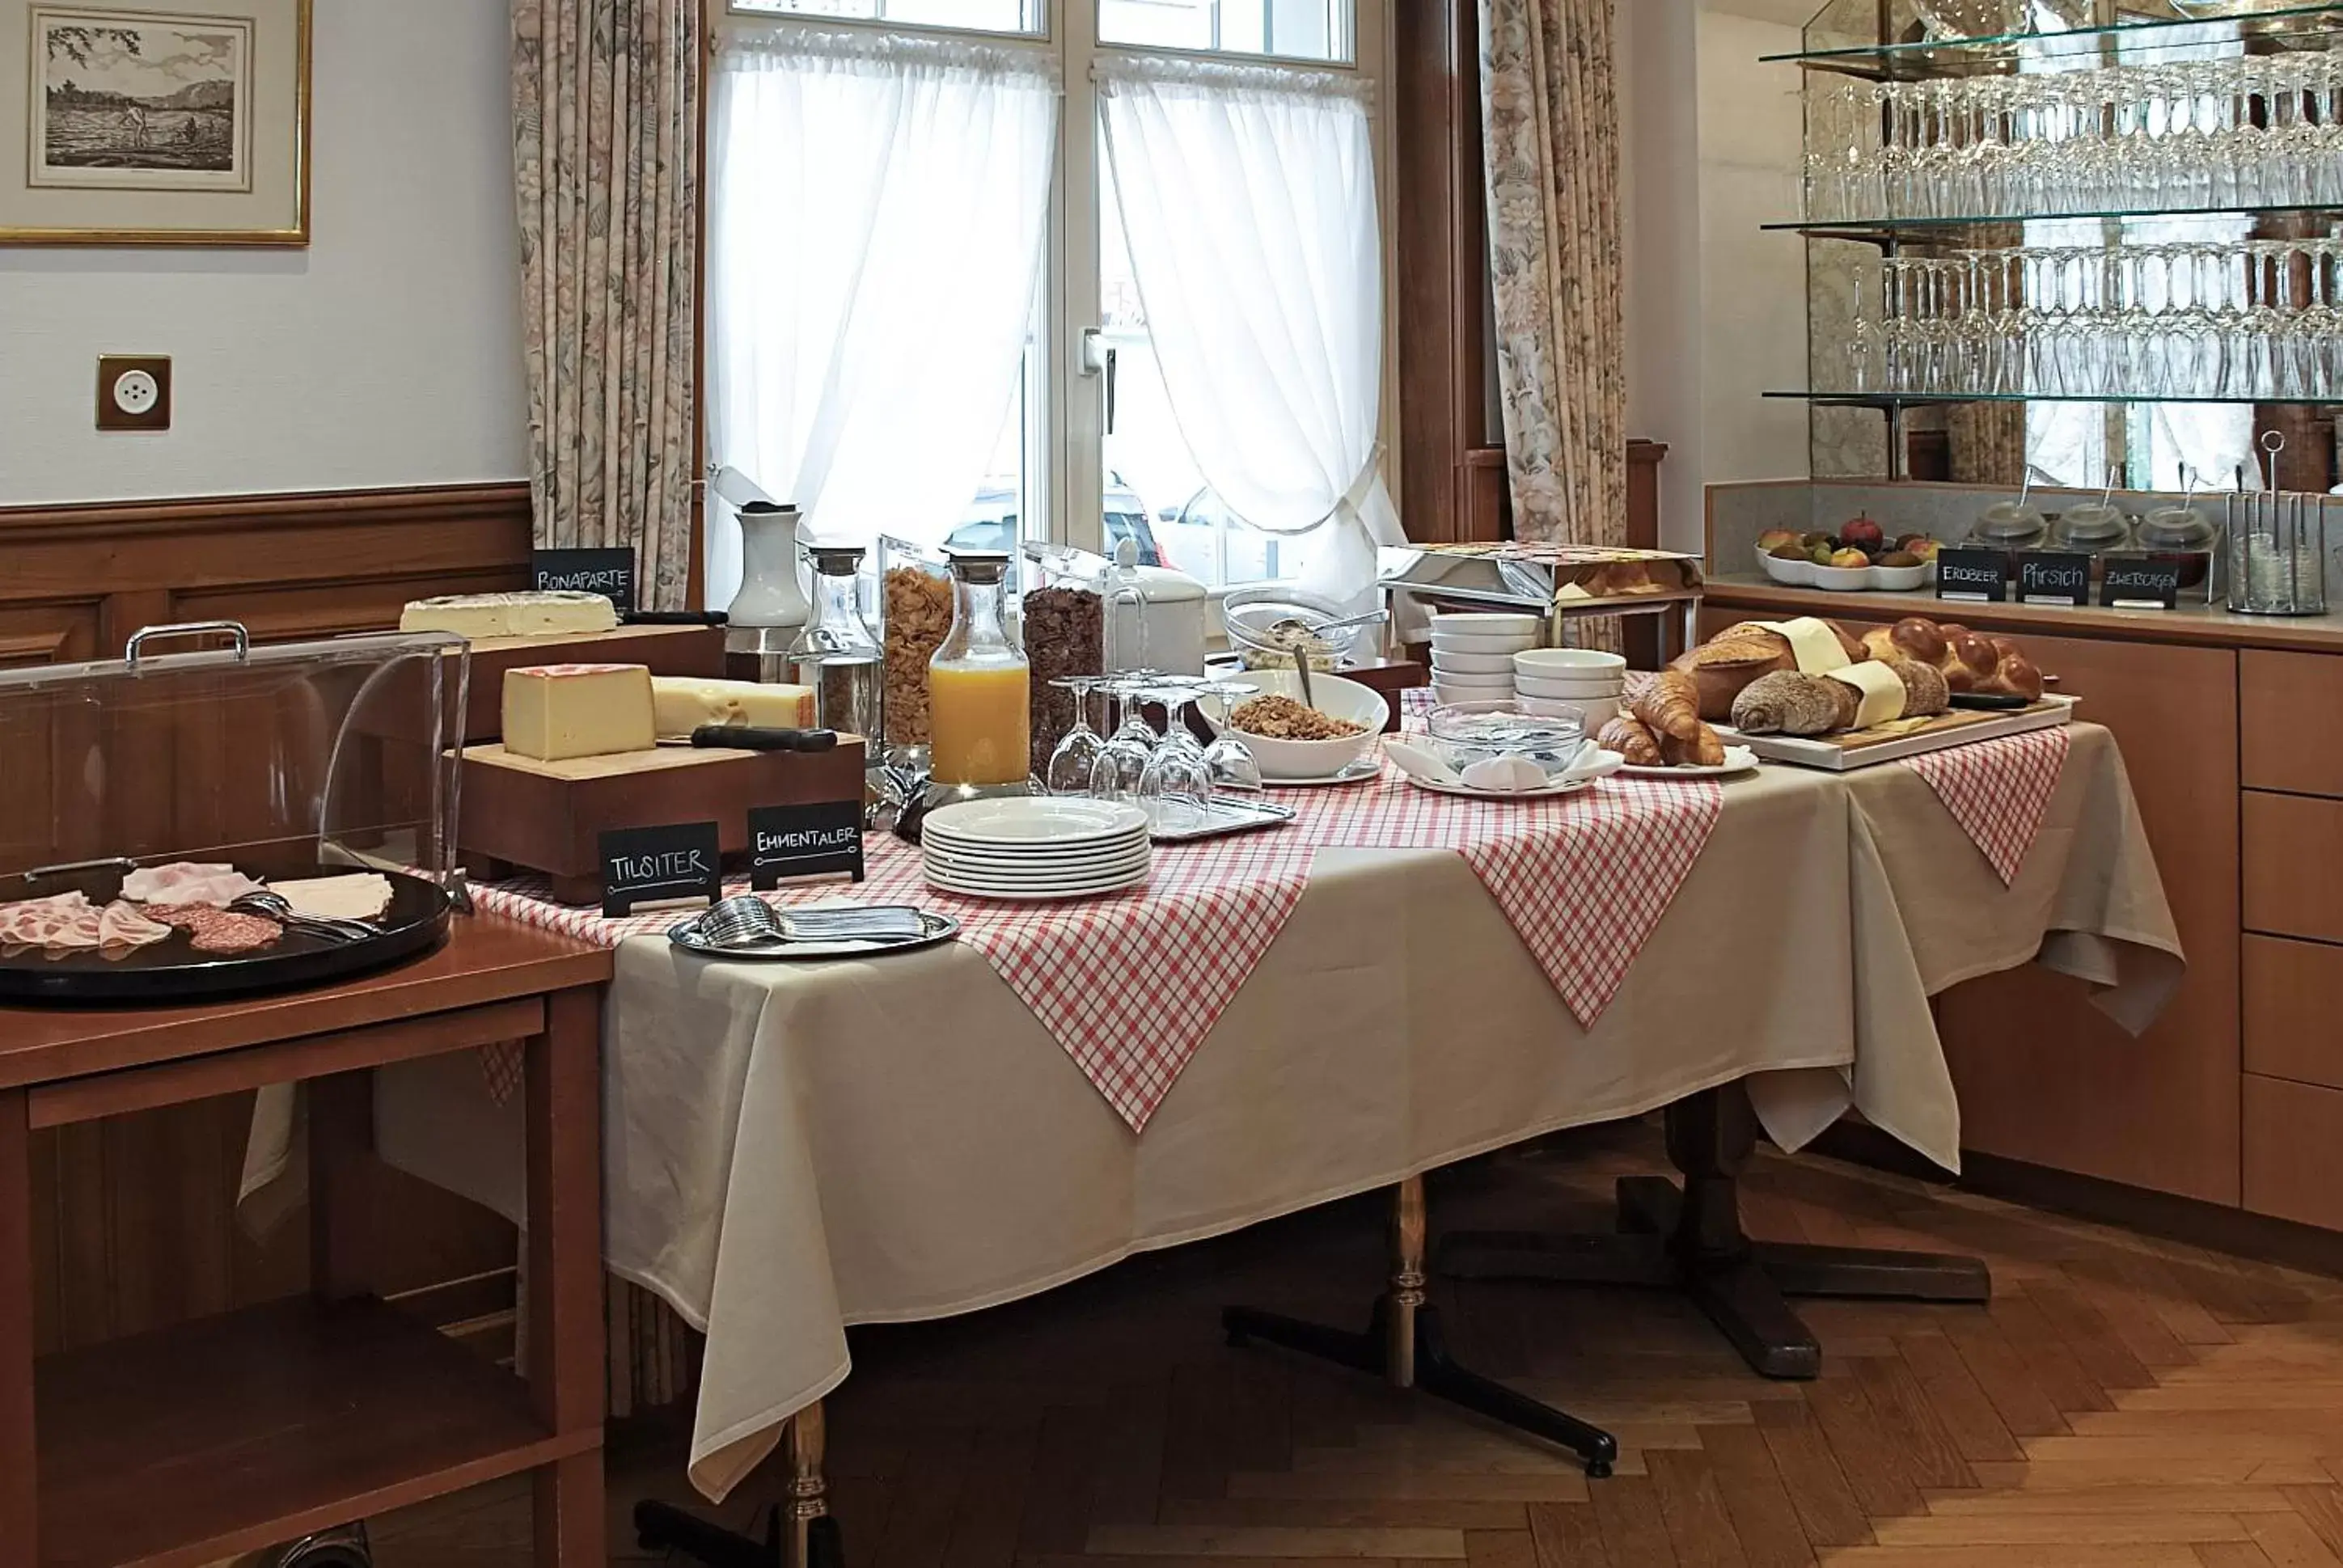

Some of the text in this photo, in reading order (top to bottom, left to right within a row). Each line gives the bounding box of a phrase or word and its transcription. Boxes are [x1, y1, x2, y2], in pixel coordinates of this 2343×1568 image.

[538, 569, 629, 590] BONAPARTE
[1943, 566, 1998, 583] ERDBEER
[2024, 563, 2083, 589] Pfirsich
[757, 826, 858, 852] EMMENTALER
[611, 849, 710, 881] TILSITER
